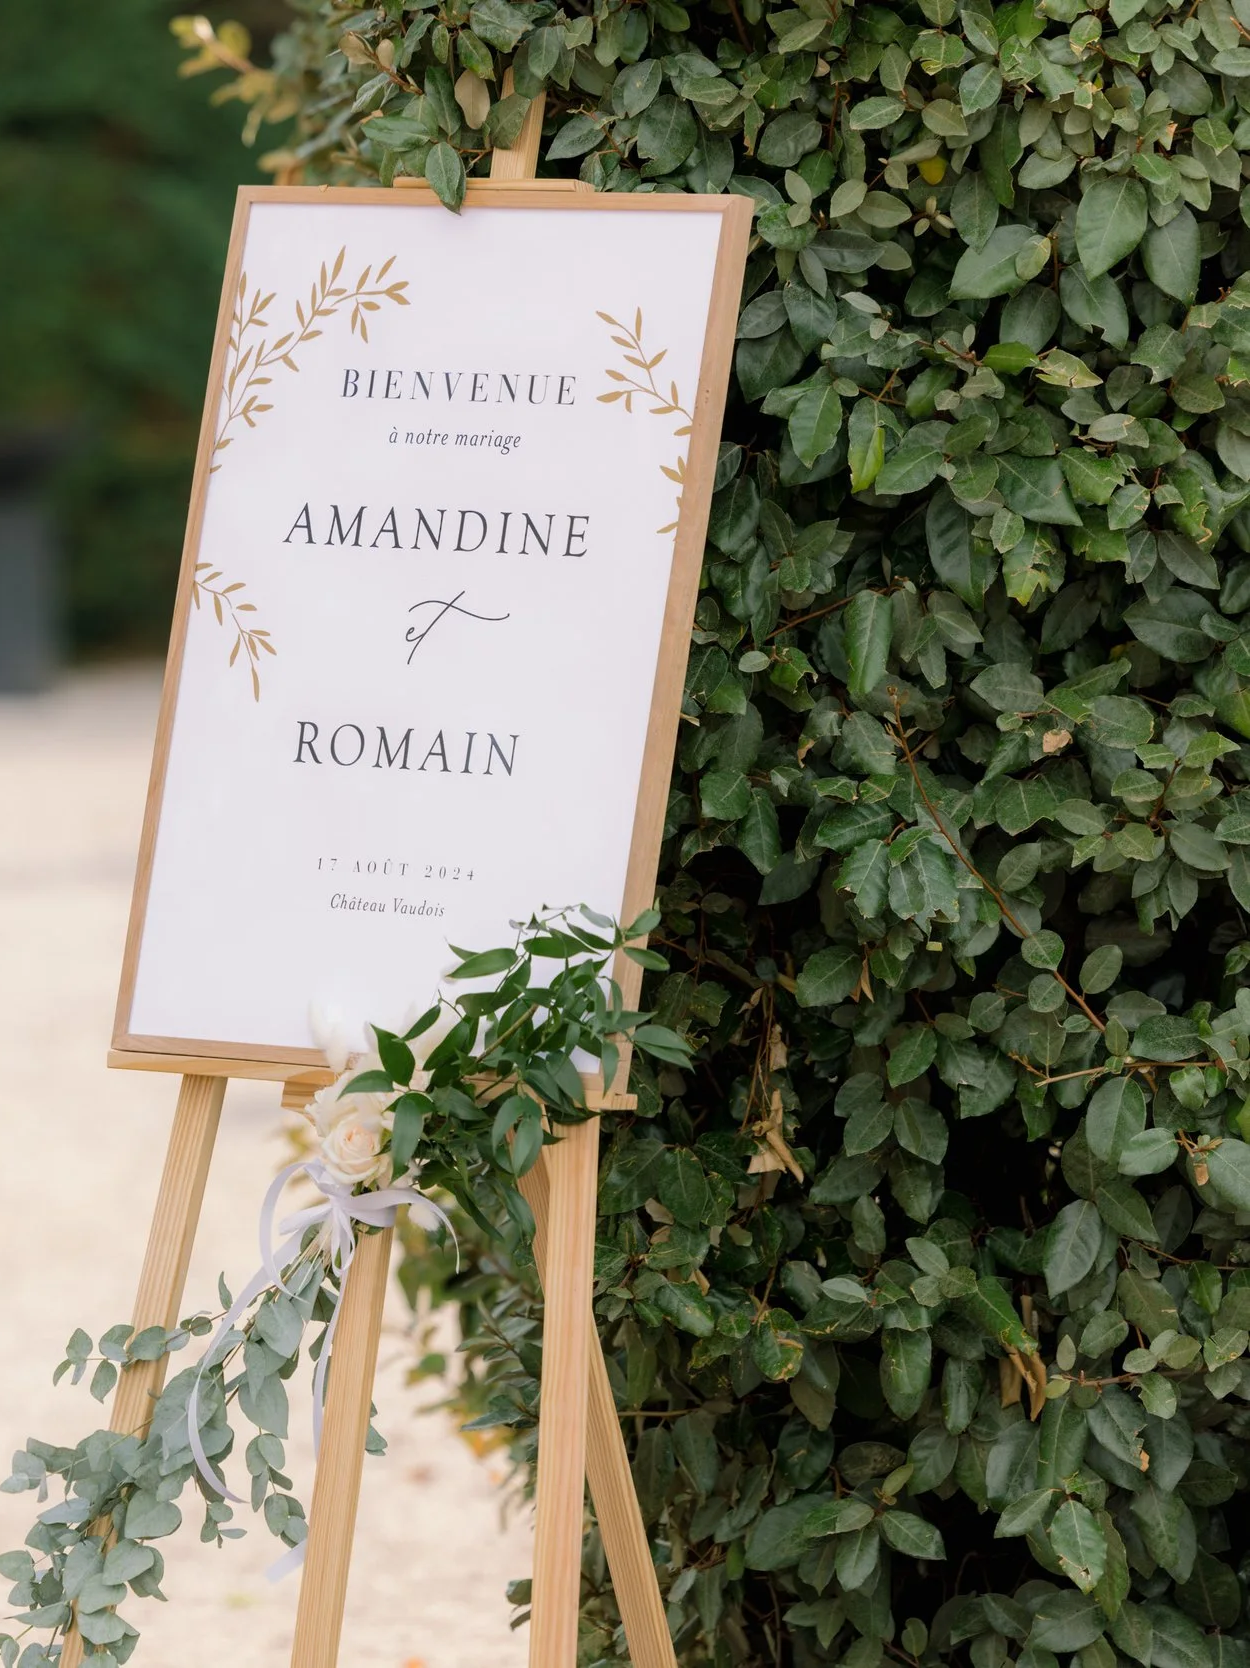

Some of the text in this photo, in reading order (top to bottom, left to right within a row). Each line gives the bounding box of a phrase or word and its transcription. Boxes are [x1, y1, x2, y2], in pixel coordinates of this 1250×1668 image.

[340, 368, 578, 406] BIENVENUE
[388, 426, 522, 456] à notre mariage
[282, 502, 590, 558] AMANDINE
[405, 590, 511, 666] et
[292, 720, 520, 777] ROMAIN
[317, 857, 475, 881] 17 AOÛT 2024
[330, 893, 446, 917] Château Vaudois
